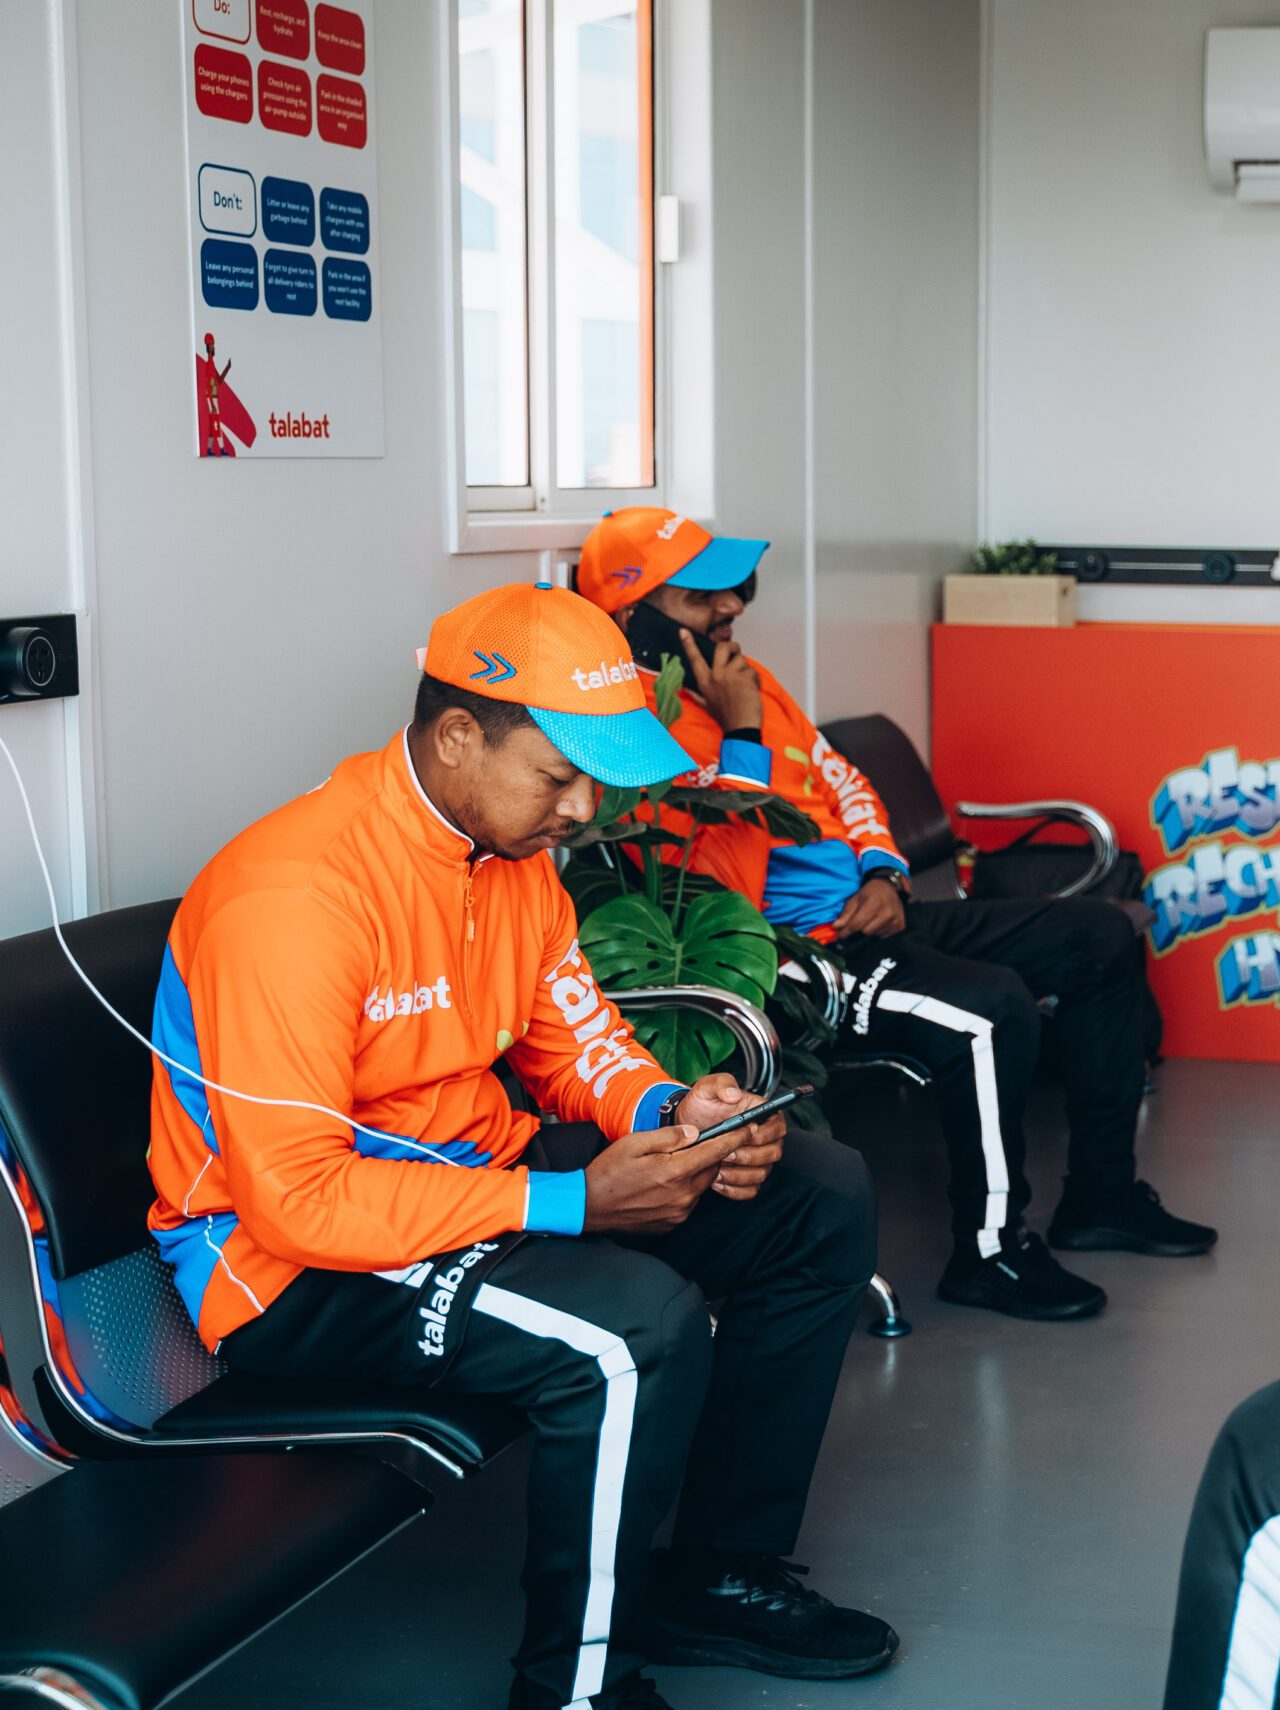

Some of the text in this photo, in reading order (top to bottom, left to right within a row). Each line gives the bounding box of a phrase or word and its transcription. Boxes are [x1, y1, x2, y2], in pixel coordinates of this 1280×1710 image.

[214, 0, 231, 15] Do:
[198, 66, 249, 87] Charge your phones
[268, 76, 283, 89] Check
[200, 83, 248, 101] using the chargers
[213, 190, 243, 211] Don't:
[205, 260, 255, 275] Leave any personal
[207, 275, 254, 289] belongings behind
[269, 412, 330, 438] talabat
[852, 957, 897, 1036] talabat
